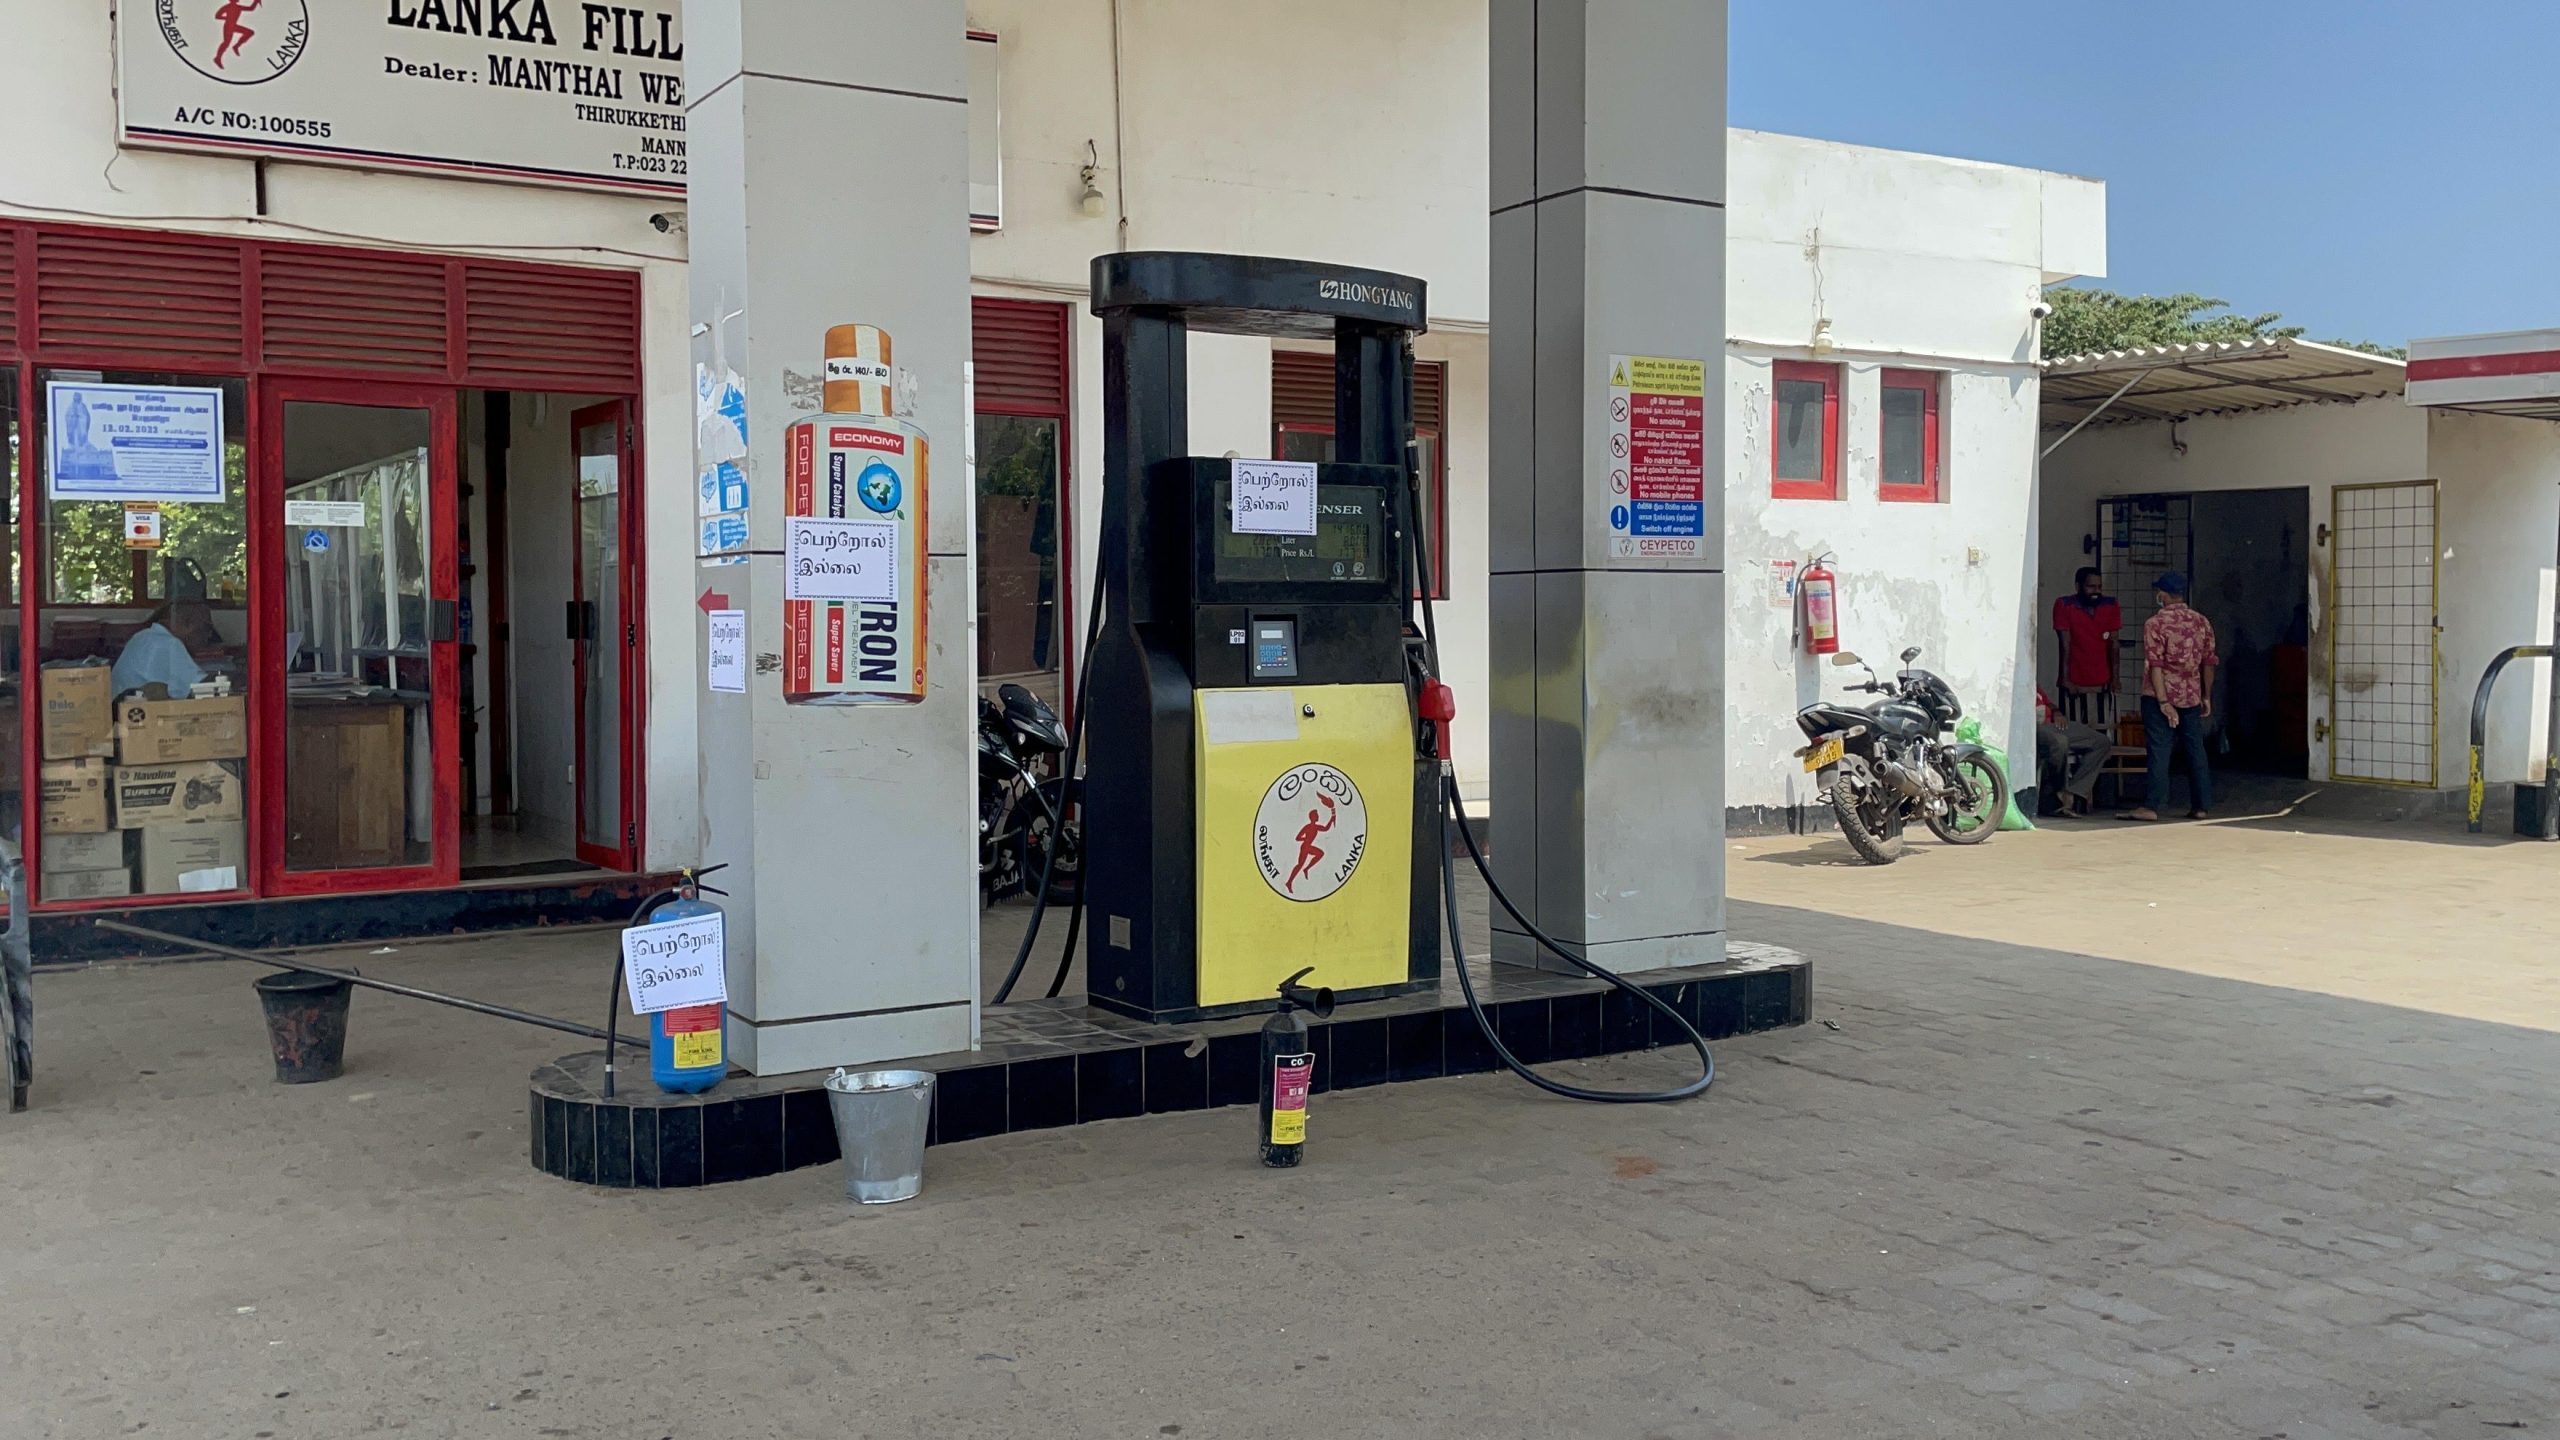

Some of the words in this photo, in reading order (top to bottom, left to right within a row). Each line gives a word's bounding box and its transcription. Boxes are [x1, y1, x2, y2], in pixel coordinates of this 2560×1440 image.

[387, 0, 557, 45] LANKA
[581, 2, 684, 61] FILL
[266, 19, 304, 70] LANKA
[487, 54, 623, 99] MANTHAI
[639, 71, 686, 106] WE
[174, 106, 215, 125] A/C
[221, 110, 331, 138] NO:100555
[612, 153, 666, 173] T.P:023
[1339, 281, 1413, 310] HONGYANG
[1649, 416, 1658, 425] No
[1659, 417, 1686, 428] smoking
[834, 433, 902, 448] ECONOMY
[799, 433, 809, 476] FOR
[1643, 455, 1653, 464] No
[1654, 456, 1673, 465] naked
[832, 455, 843, 482] Super
[1241, 471, 1309, 492] பெற்றோல்
[832, 483, 844, 519] Catalys
[1241, 496, 1289, 513] இல்லை
[1640, 490, 1649, 498] No
[1649, 491, 1671, 499] mobile
[1672, 491, 1695, 500] phones
[1317, 504, 1363, 515] ENSER
[1281, 536, 1296, 544] Liter
[1641, 524, 1662, 533] Switch
[1663, 525, 1672, 533] off
[1673, 526, 1694, 534] engine
[799, 530, 886, 552] பெற்றோல்
[1640, 539, 1695, 551] CEYPETCO
[1281, 549, 1296, 557] Price
[799, 557, 862, 577] இல்லை
[831, 619, 841, 645] Super
[831, 647, 841, 672] Saver
[851, 619, 859, 680] TREATMENT
[133, 770, 176, 781] Havoline
[124, 788, 156, 797] SUPER
[1278, 768, 1353, 806] ලංකා
[1335, 833, 1364, 882] LANKA
[636, 928, 716, 958] பெற்றோல்
[641, 963, 704, 989] இல்லை
